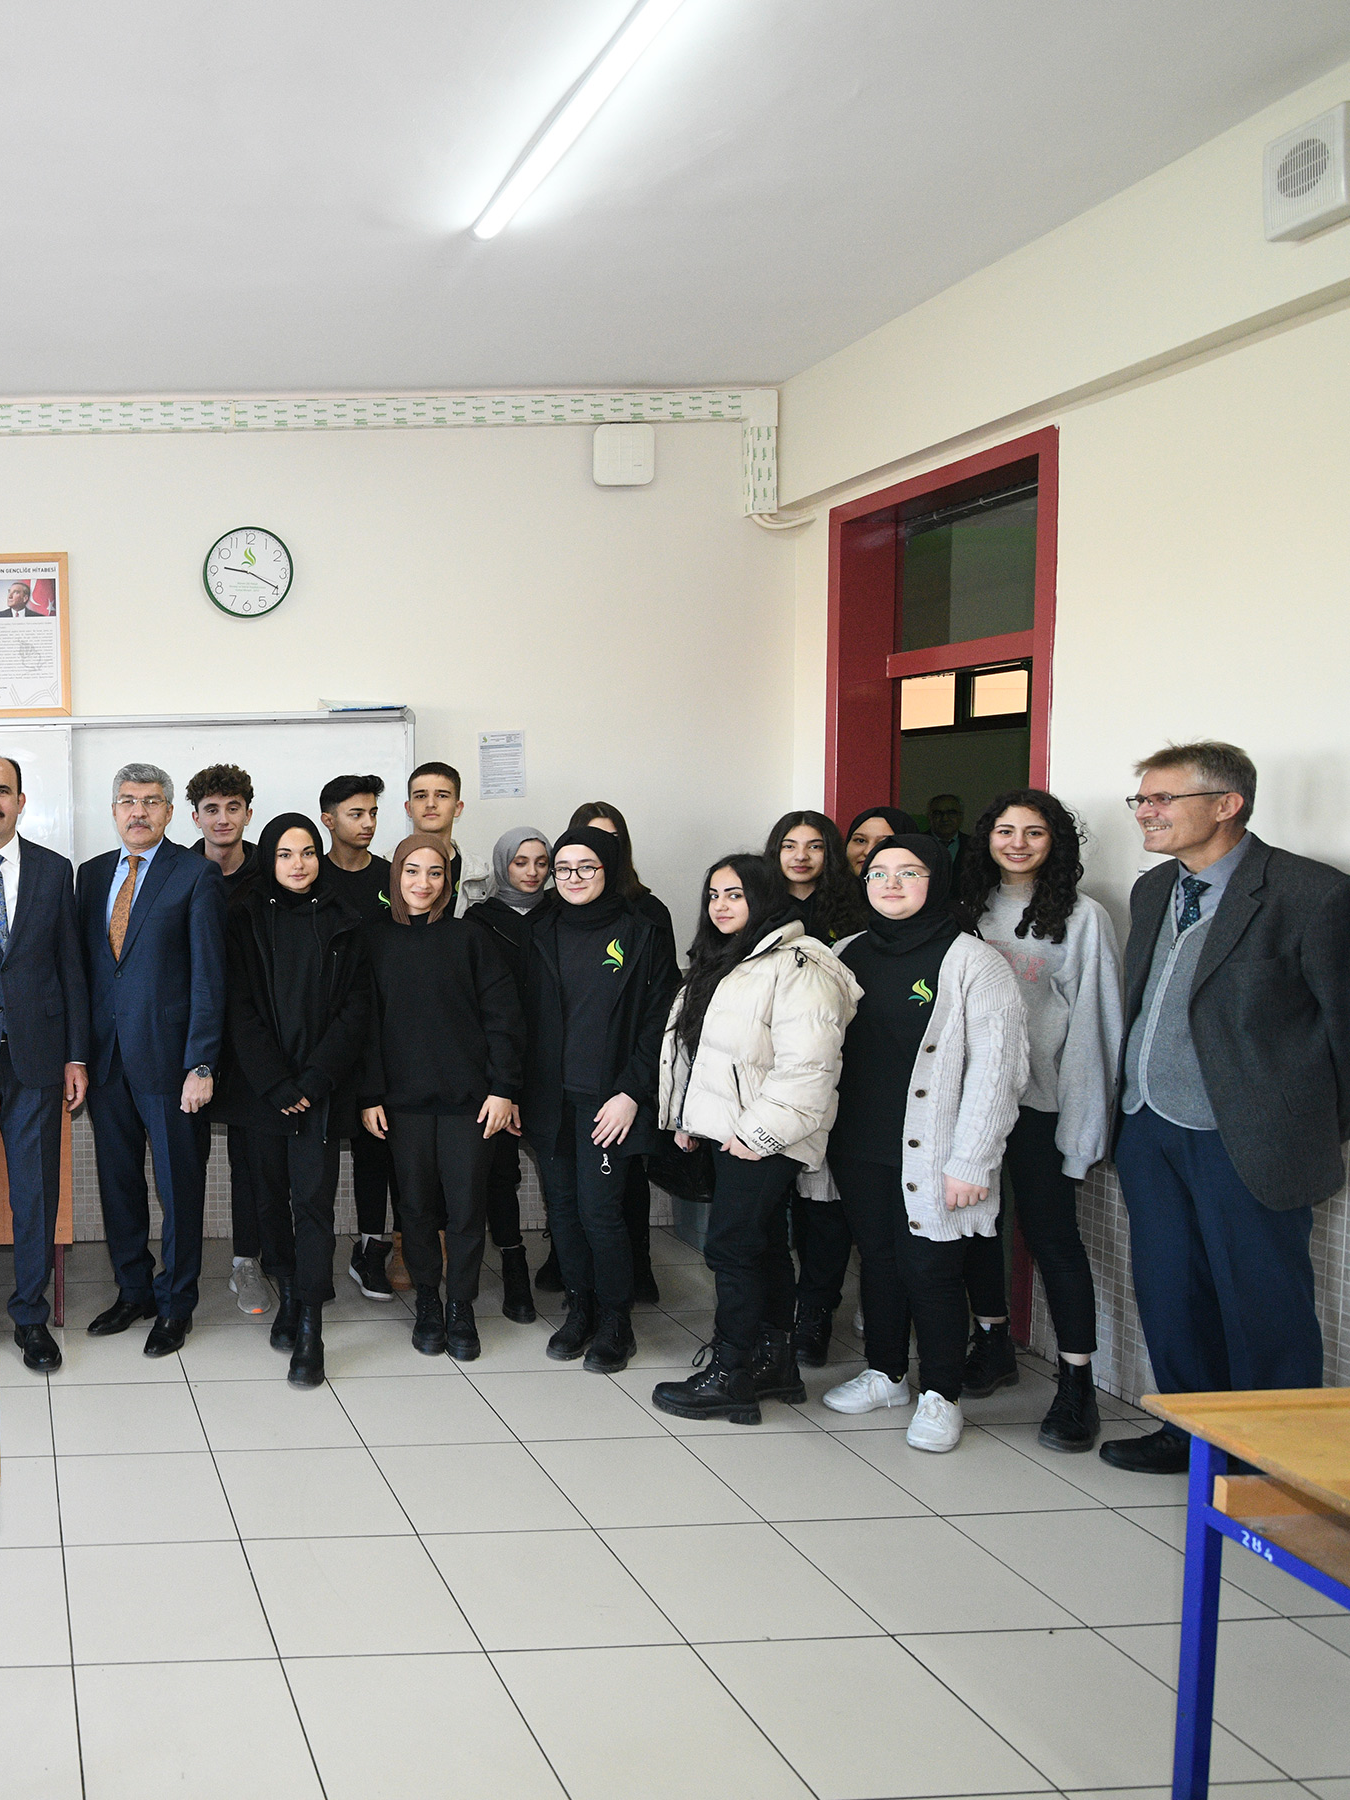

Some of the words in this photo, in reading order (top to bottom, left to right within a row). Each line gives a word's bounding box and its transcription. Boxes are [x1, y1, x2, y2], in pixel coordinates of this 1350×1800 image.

[230, 537, 238, 549] 11
[245, 532, 256, 545] 12
[264, 538, 268, 550] 1
[218, 547, 231, 560] 10
[273, 549, 282, 562] 2
[210, 565, 219, 577] 9
[279, 567, 287, 579] 3
[215, 581, 224, 594] 8
[271, 584, 279, 595] 4
[229, 595, 237, 607] 7
[242, 600, 251, 611] 6
[258, 596, 267, 608] 5
[1241, 1530, 1273, 1562] 284
